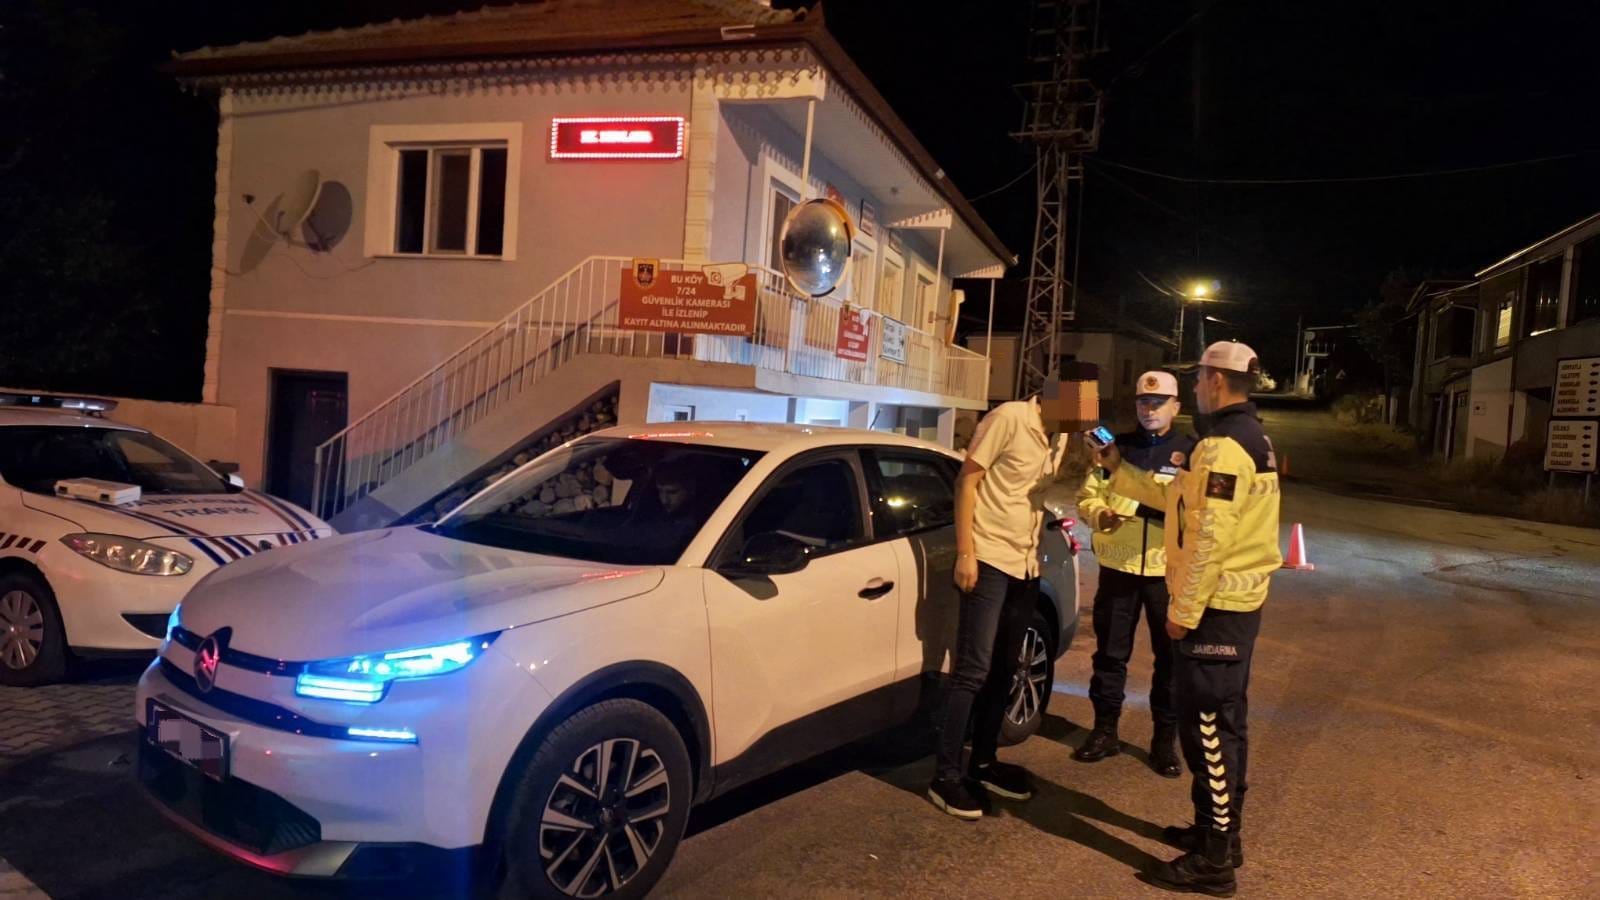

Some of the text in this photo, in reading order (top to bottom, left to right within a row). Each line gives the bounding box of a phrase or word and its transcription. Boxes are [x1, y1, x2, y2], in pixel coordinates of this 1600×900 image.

[671, 273, 703, 284] BU KÖY
[676, 287, 696, 296] 7/24
[641, 295, 731, 309] GÜVENLİK KAMERASI
[662, 308, 709, 319] İLE İZLENİP
[624, 317, 746, 332] KAYIT ALTINA ALINMAKTADIR
[1191, 644, 1238, 656] JANDARMA
